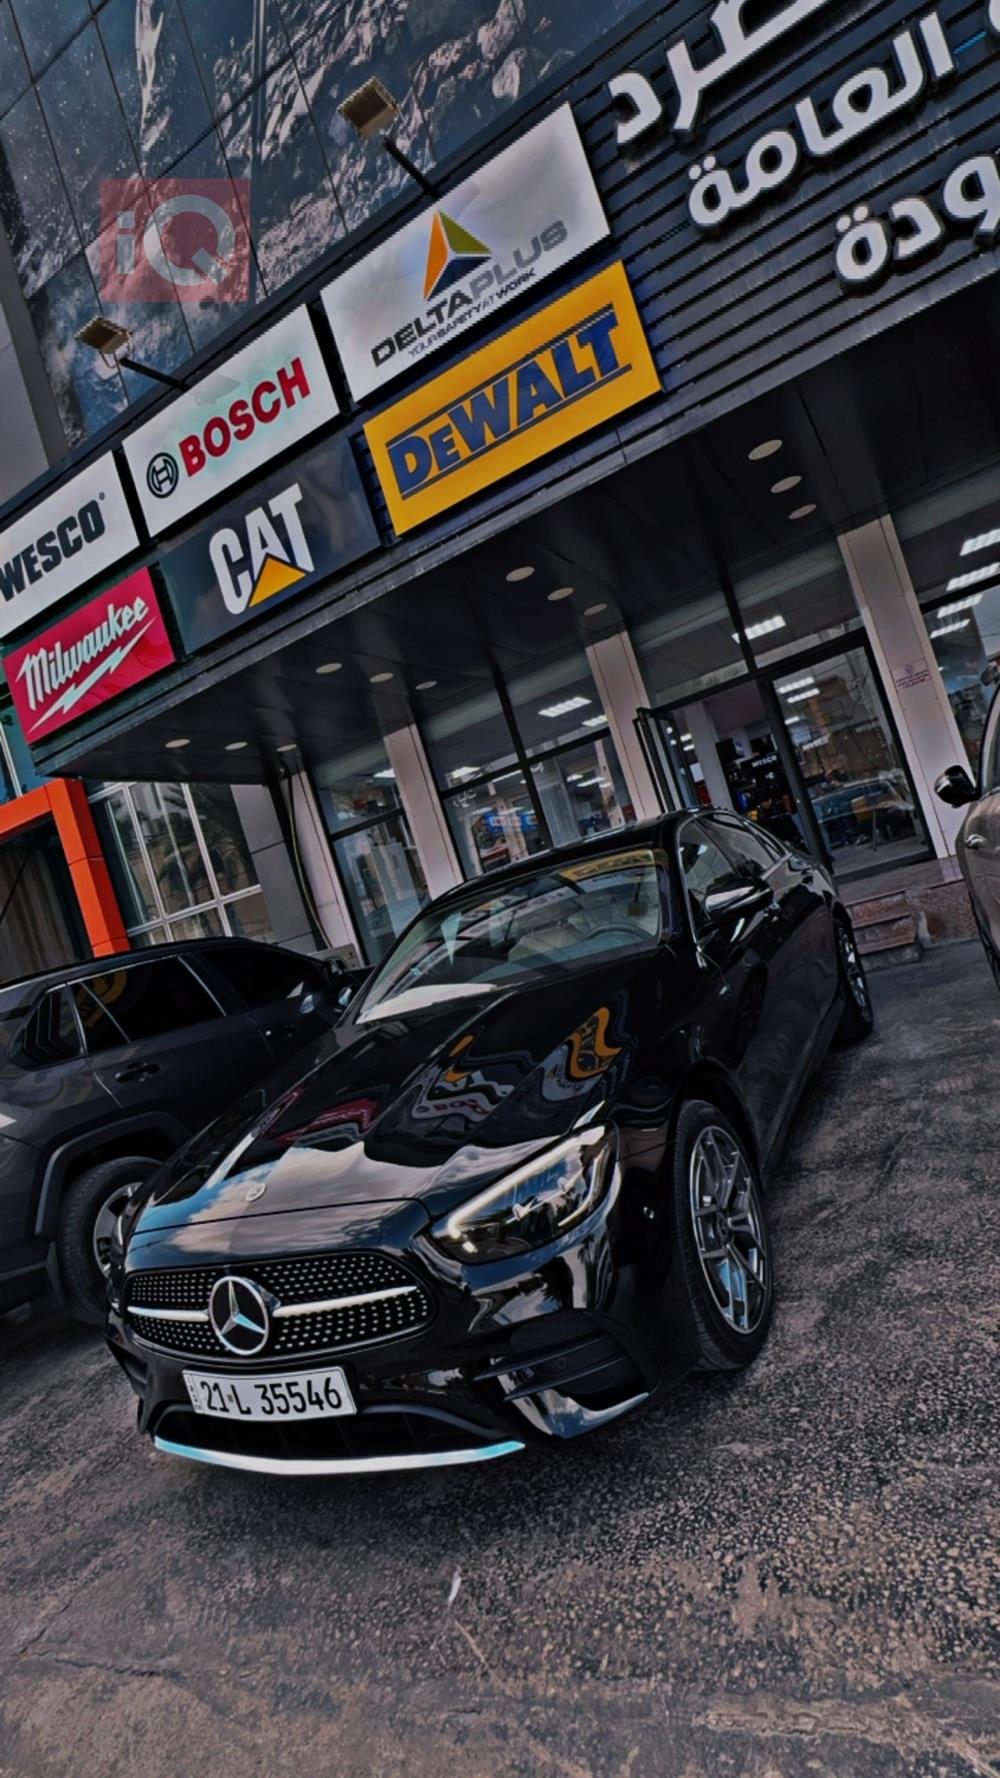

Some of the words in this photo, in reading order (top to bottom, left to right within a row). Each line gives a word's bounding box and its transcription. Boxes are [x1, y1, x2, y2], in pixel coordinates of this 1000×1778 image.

[688, 11, 954, 226] العامة
[495, 267, 536, 299] WORK
[179, 357, 311, 477] BOSCH
[0, 500, 105, 602] WESCO
[209, 482, 314, 614] CAT
[16, 597, 149, 710] Milwaukee
[254, 1377, 343, 1415] 35546
